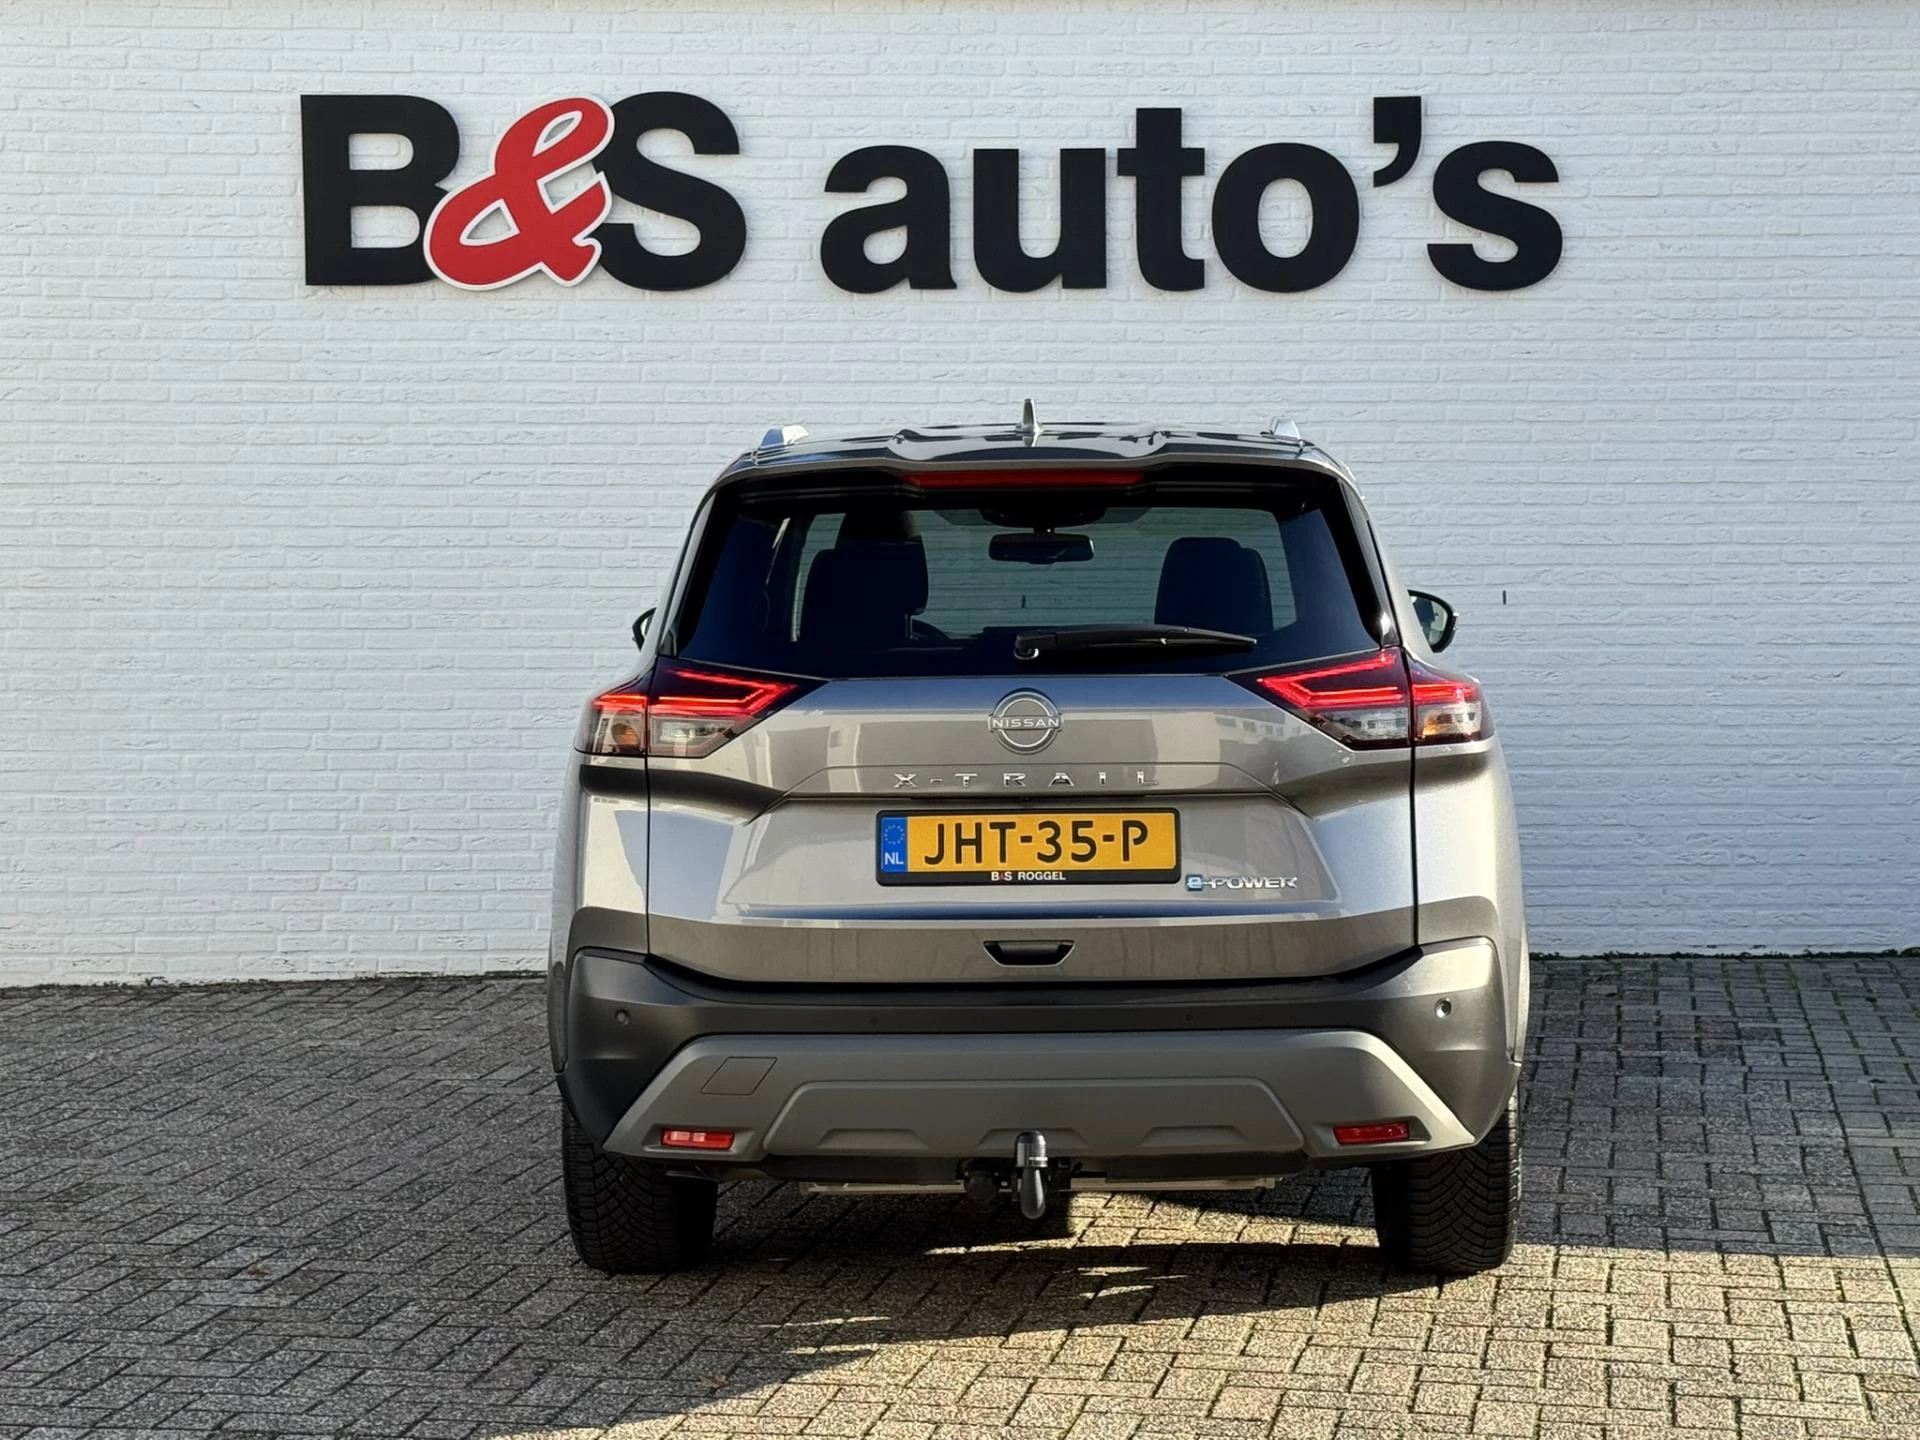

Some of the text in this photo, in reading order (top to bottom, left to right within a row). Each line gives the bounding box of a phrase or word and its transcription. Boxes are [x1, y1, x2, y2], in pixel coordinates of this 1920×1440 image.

[301, 91, 1563, 292] B&S auto's
[992, 718, 1060, 728] NISSAN
[893, 772, 1159, 788] X-TRAIL
[924, 820, 1148, 864] JHT-35-P
[885, 852, 904, 865] NL
[1017, 871, 1066, 881] ROGGEL
